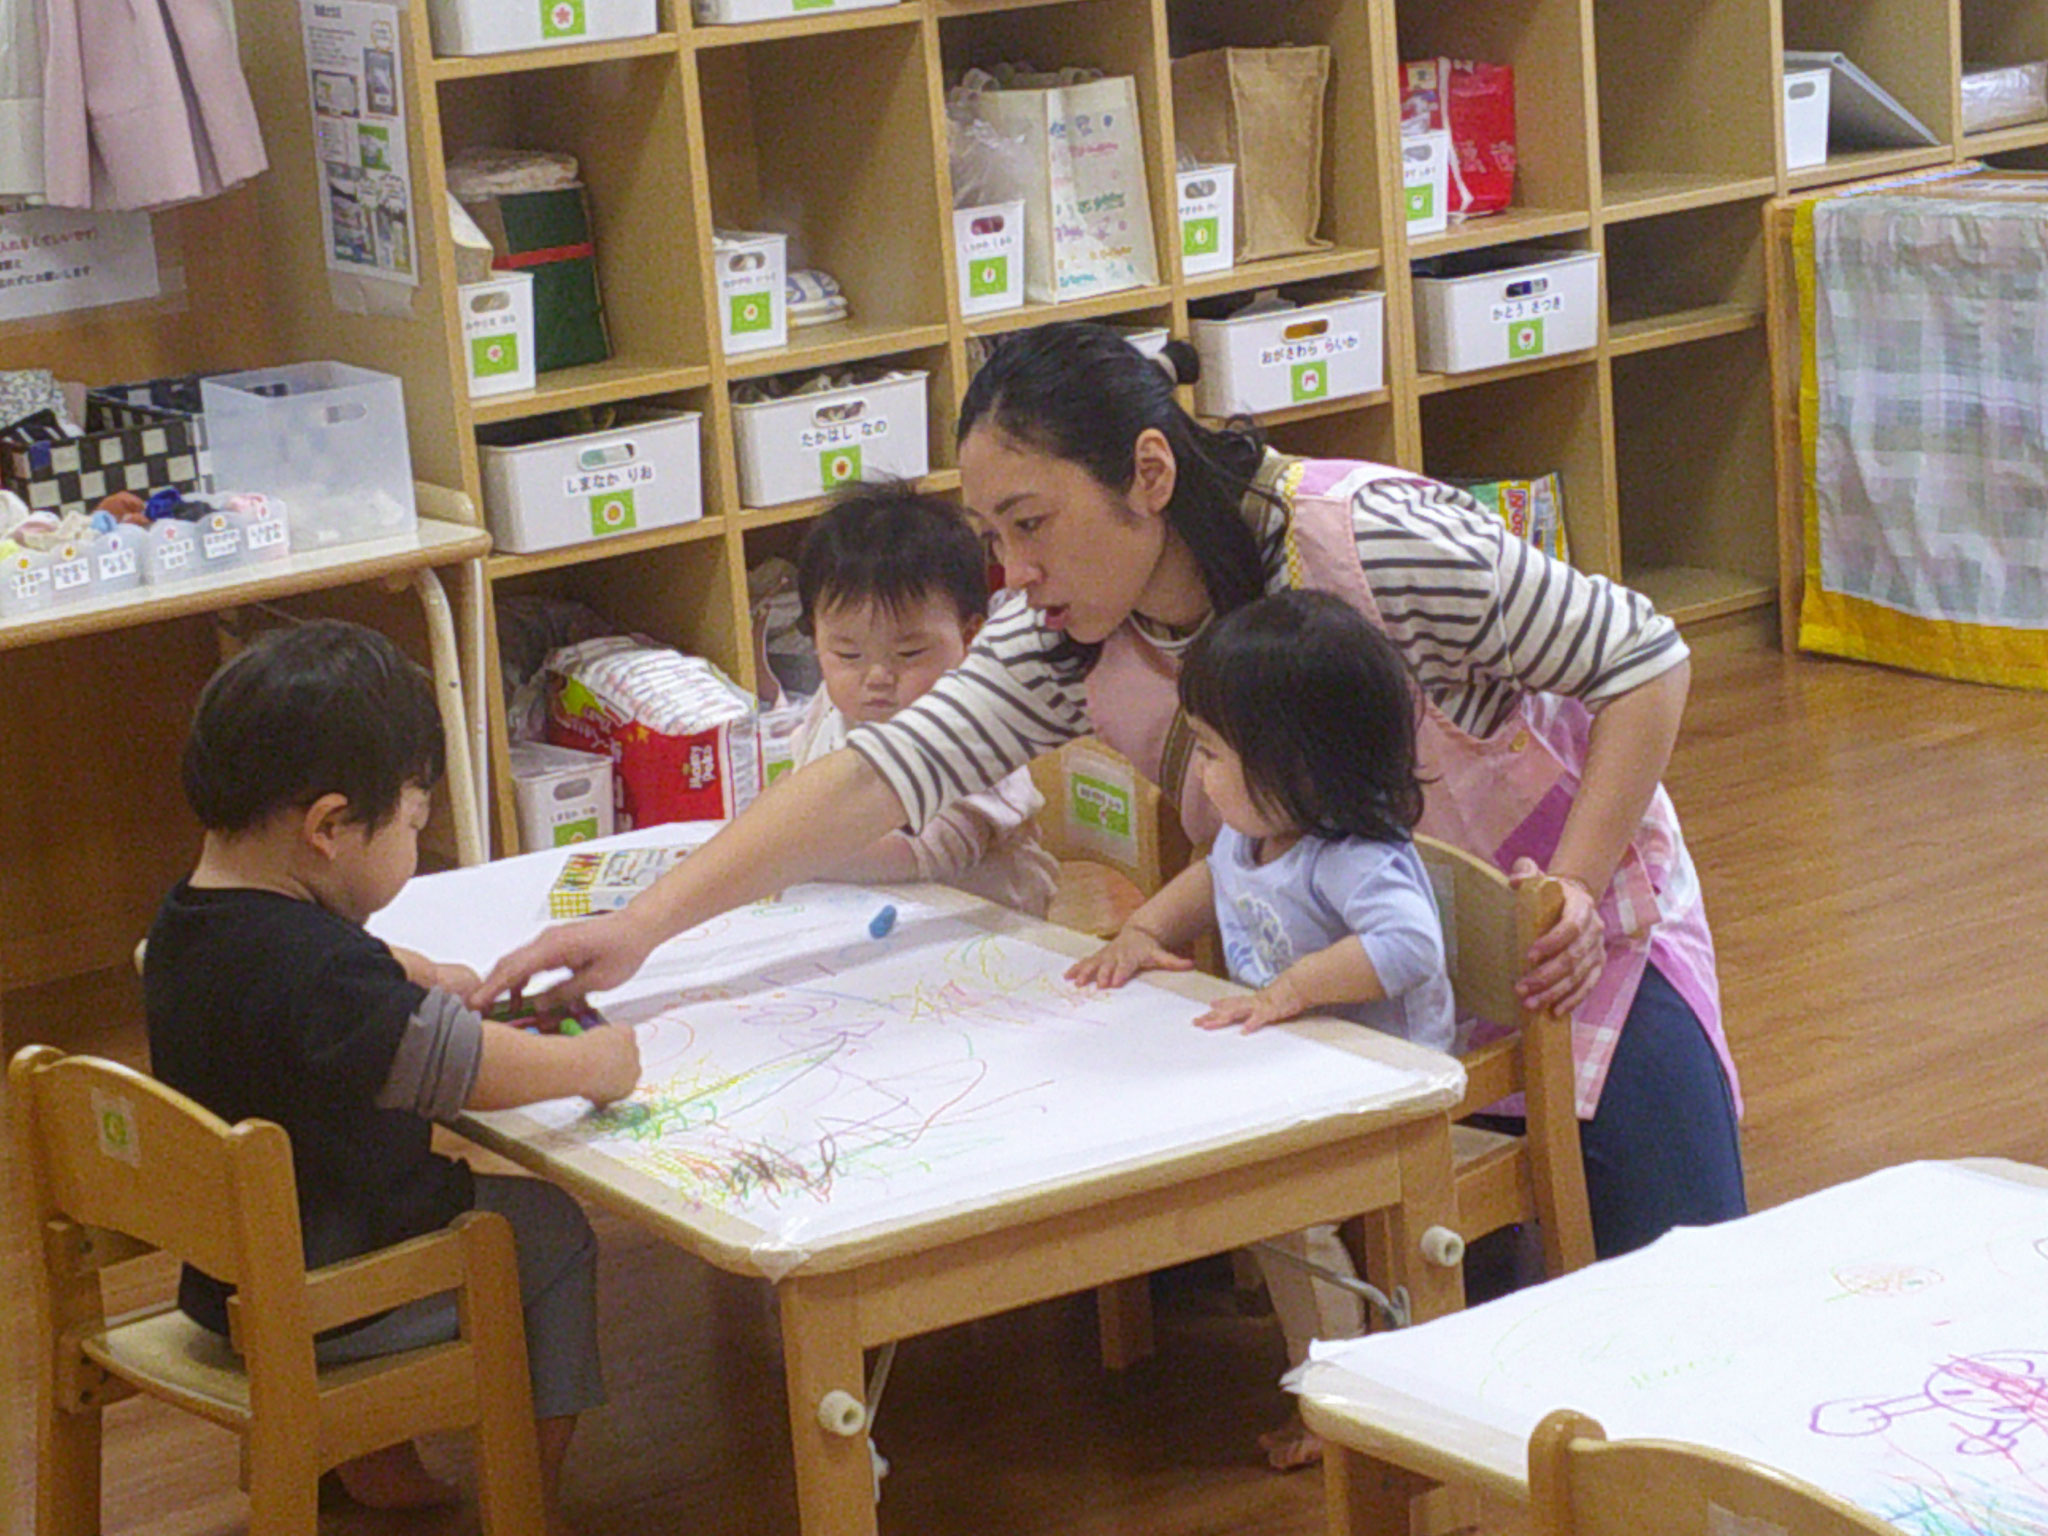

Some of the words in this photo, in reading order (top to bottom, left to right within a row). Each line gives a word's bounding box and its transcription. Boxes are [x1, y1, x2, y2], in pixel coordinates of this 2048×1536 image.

[801, 425, 853, 447] たかはし
[861, 420, 888, 436] なの
[566, 472, 620, 494] しまなか
[627, 464, 653, 482] りお
